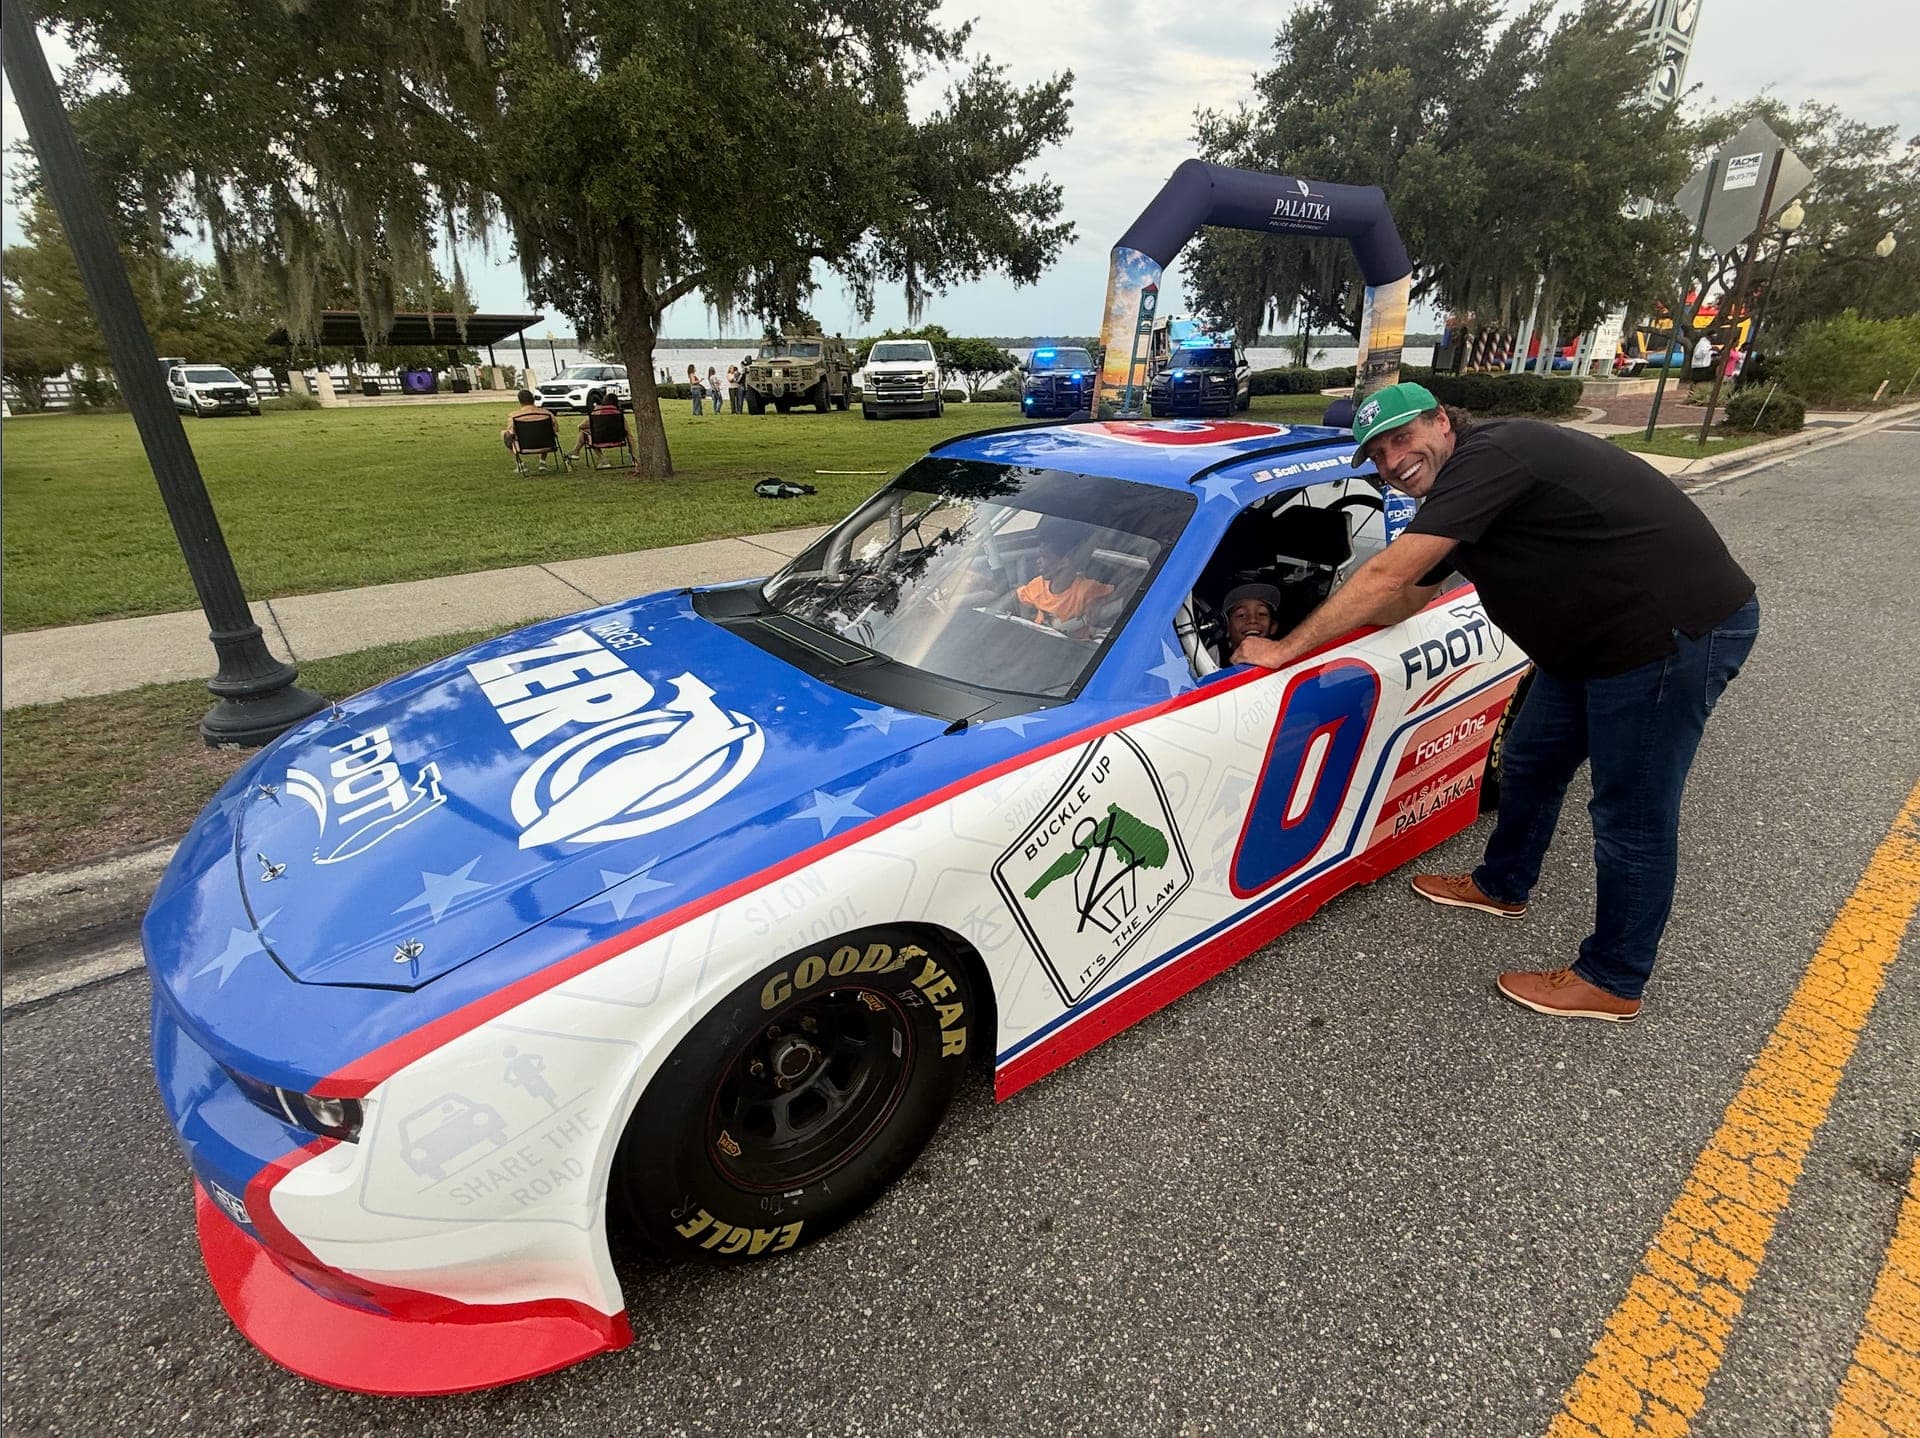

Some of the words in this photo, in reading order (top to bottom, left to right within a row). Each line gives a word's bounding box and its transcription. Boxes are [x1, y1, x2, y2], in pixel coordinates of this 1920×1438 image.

[1268, 220, 1289, 228] POLICE
[1273, 198, 1331, 221] PALATKA
[1271, 465, 1302, 479] Scott
[1300, 457, 1340, 472] Lagasse
[591, 620, 653, 652] TARGET
[1399, 618, 1487, 691] FDOT
[329, 726, 410, 825] FDOT
[1229, 656, 1382, 900] 0
[1392, 771, 1476, 839] PALATKA
[1398, 774, 1448, 813] VISIT
[1023, 785, 1092, 862] BUCKLE
[1091, 755, 1113, 785] UP
[1078, 953, 1107, 985] IT'S
[1111, 916, 1143, 948] THE
[1146, 879, 1176, 914] LAW
[449, 1145, 544, 1207] SHARE
[540, 1107, 601, 1149] THE
[511, 1157, 586, 1207] ROAD
[674, 1208, 805, 1256] EAGLE
